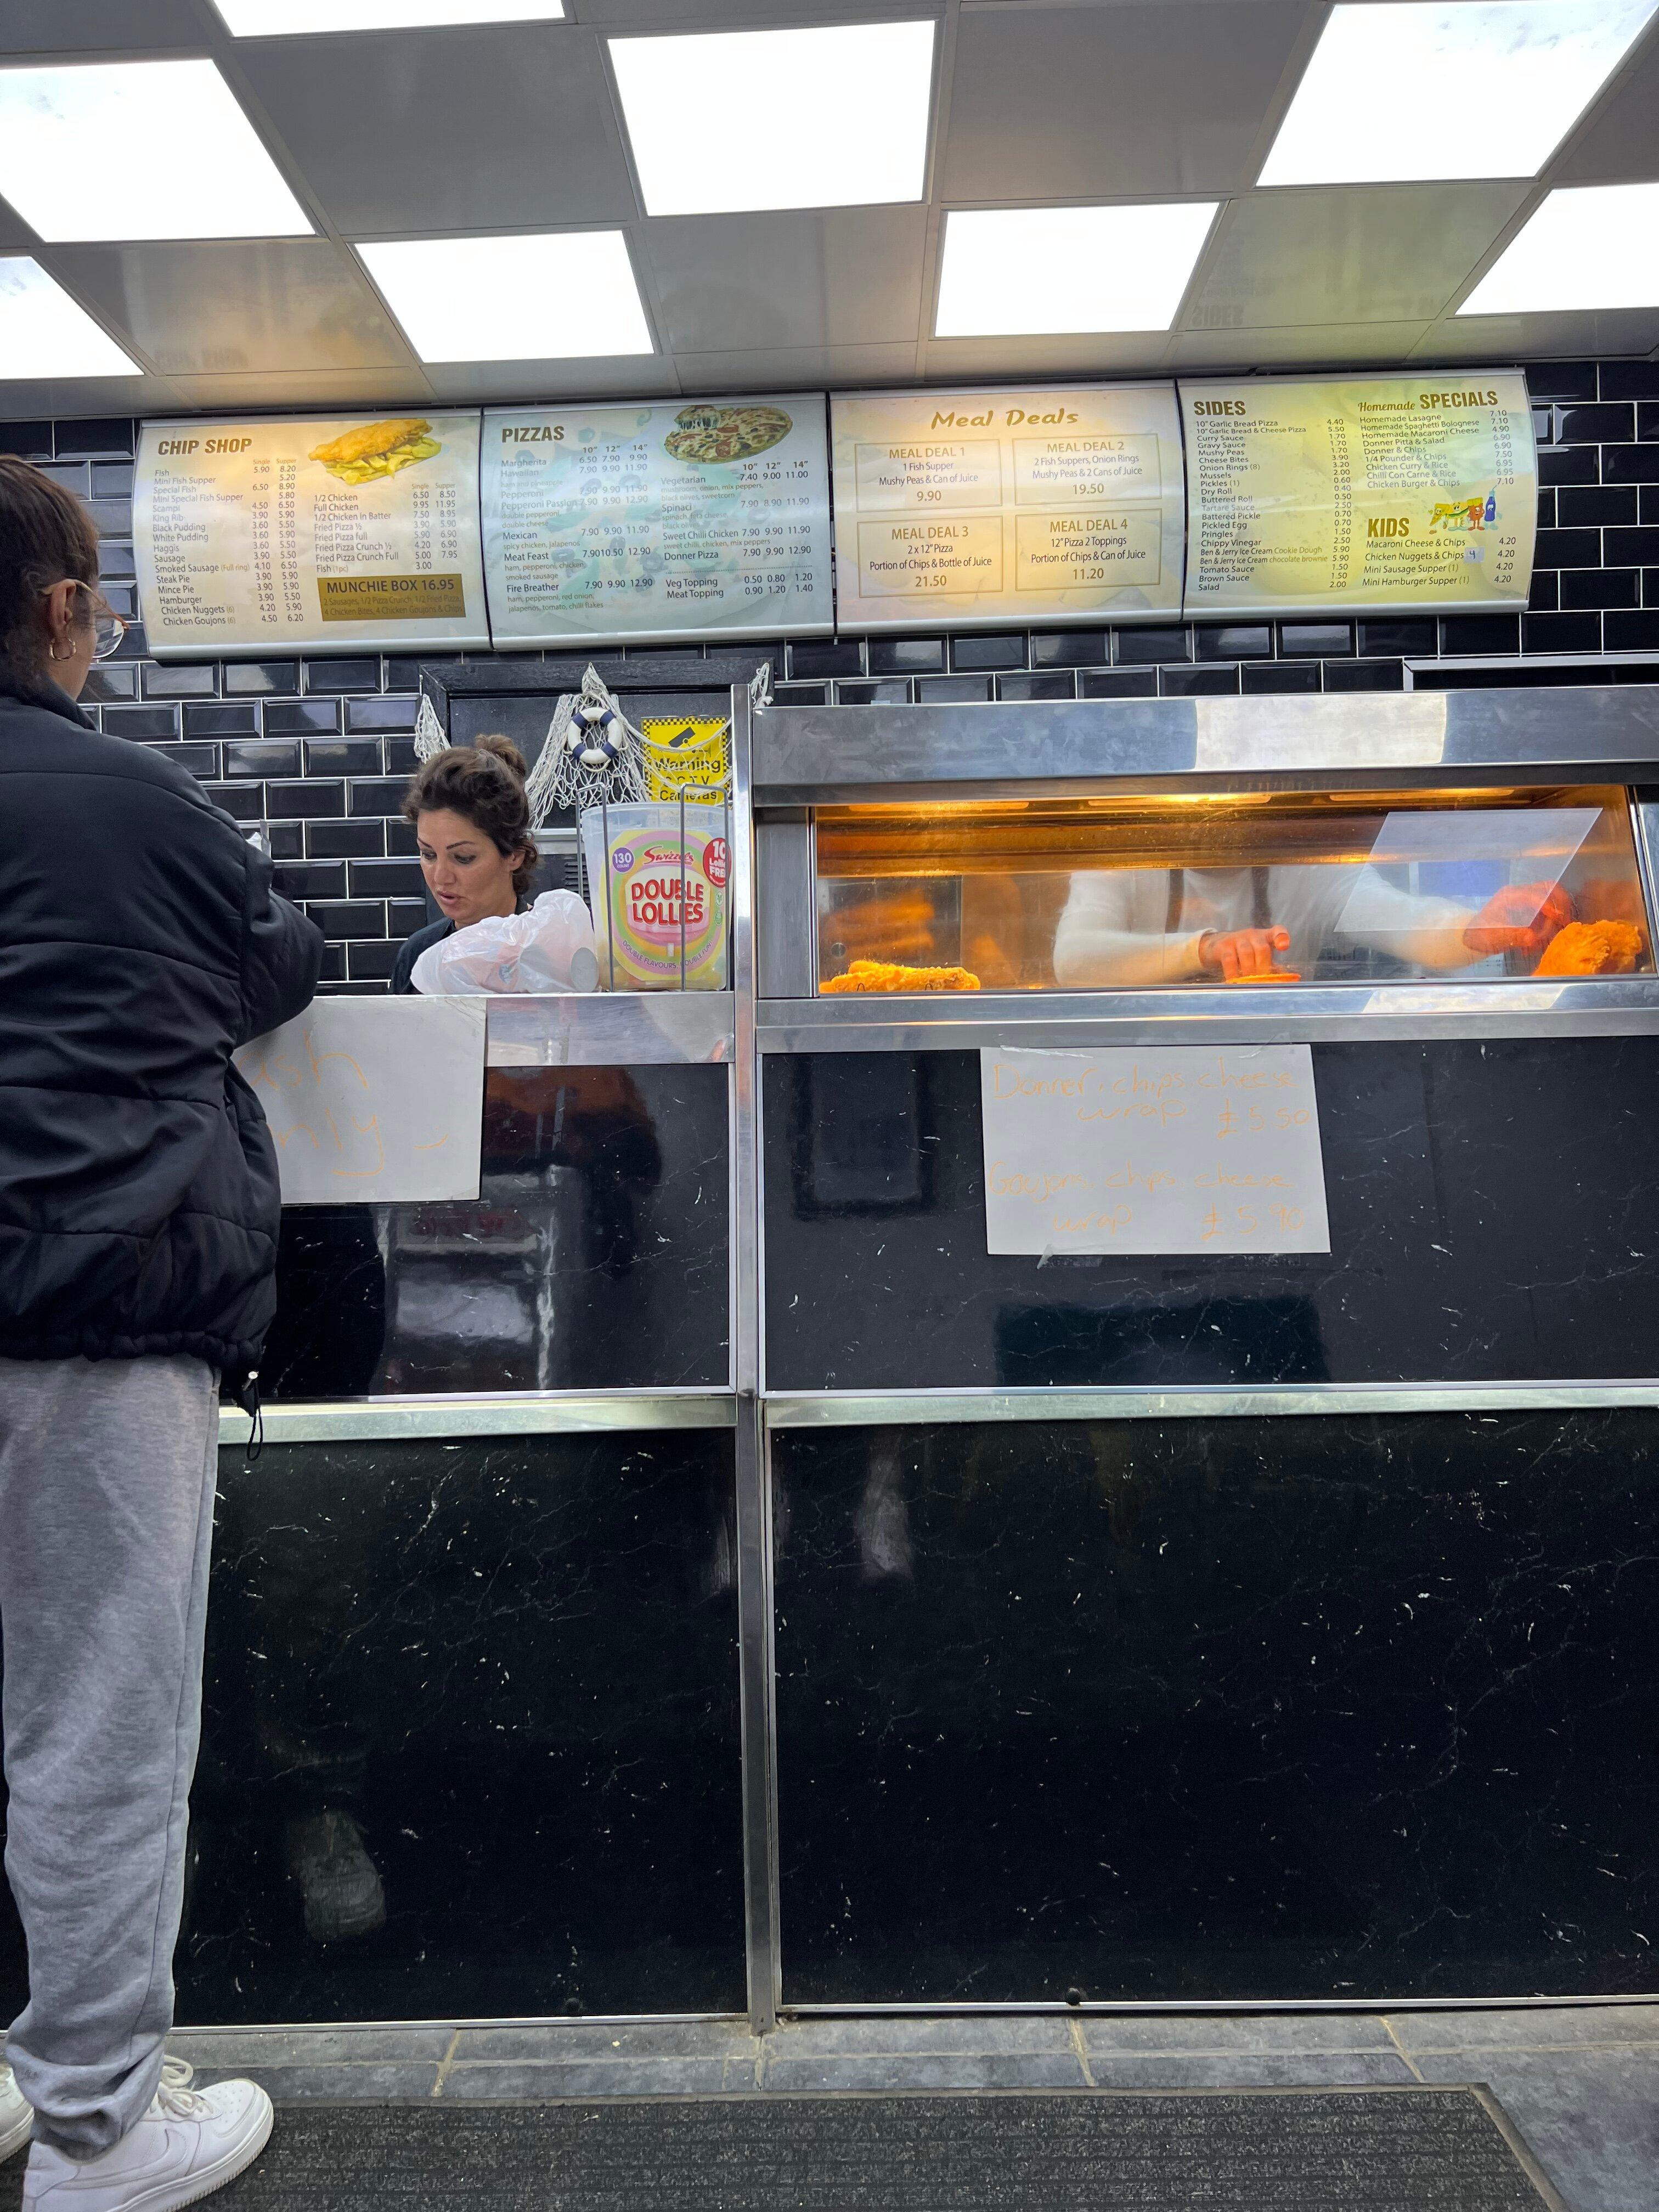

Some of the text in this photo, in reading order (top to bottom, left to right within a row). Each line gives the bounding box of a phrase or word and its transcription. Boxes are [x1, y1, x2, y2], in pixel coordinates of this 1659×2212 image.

[1358, 391, 1498, 412] Homemade SPECIALS
[1194, 401, 1246, 415] SIDES
[931, 409, 1079, 430] Meal Deals
[1408, 414, 1441, 422] Lasagne
[502, 426, 565, 443] PIZZAS
[158, 438, 252, 455] CHIP SHOP
[1047, 441, 1125, 453] MEAL DEAL 2
[889, 448, 964, 459] MEAL DEAL 1
[1040, 456, 1055, 465] Fish
[1058, 456, 1091, 466] Suppers,
[1092, 455, 1115, 464] Onion
[1117, 454, 1139, 464] Rings
[909, 462, 924, 471] Fish
[926, 461, 953, 472] Supper
[1032, 470, 1058, 479] Mushy
[1093, 467, 1112, 476] Cans
[1122, 466, 1142, 475] Juice
[879, 476, 905, 487] Mushy
[906, 475, 923, 484] Peas
[933, 475, 947, 483] Can
[950, 473, 957, 482] of
[959, 473, 978, 482] Juice
[1072, 483, 1104, 494] 19.50
[916, 490, 941, 501] 9.90
[1050, 519, 1127, 532] MEAL DEAL 4
[1368, 518, 1409, 537] KIDS
[892, 527, 969, 539] MEAL DEAL 3
[1064, 538, 1084, 546] Pizza
[1092, 537, 1127, 546] Toppings
[1367, 540, 1403, 548] Macaroni
[1443, 538, 1465, 547] Chips
[907, 546, 912, 554] 2
[934, 544, 953, 553] Pizza
[1031, 550, 1146, 563] Portion of Chips & Can of Juice
[1398, 552, 1432, 561] Nuggets
[1441, 551, 1464, 560] Chips
[870, 557, 992, 571] Portion of Chips & Bottle of Juice
[1383, 565, 1415, 573] Sausage
[1418, 565, 1446, 574] Supper
[1448, 564, 1459, 572] (1)
[1073, 568, 1104, 580] 11.20
[327, 579, 454, 593] MUNCHIE BOX 16.95
[666, 579, 681, 588] Veg
[684, 578, 718, 588] Topping
[915, 575, 947, 587] 21.50
[1362, 578, 1380, 586] Mini
[1381, 578, 1427, 587] Hamburger
[1429, 577, 1457, 586] Supper
[1459, 576, 1469, 585] (1)
[507, 584, 522, 592] Fire
[160, 596, 202, 605] Hamburger
[656, 758, 720, 773] Warning
[614, 853, 631, 864] 130
[623, 940, 645, 961] DOUBLE
[237, 1028, 369, 1091] ash
[1197, 1056, 1300, 1090] cheese
[1077, 1099, 1187, 1127] wrap
[1194, 1161, 1296, 1188] cheese
[1053, 1204, 1132, 1234] wrap
